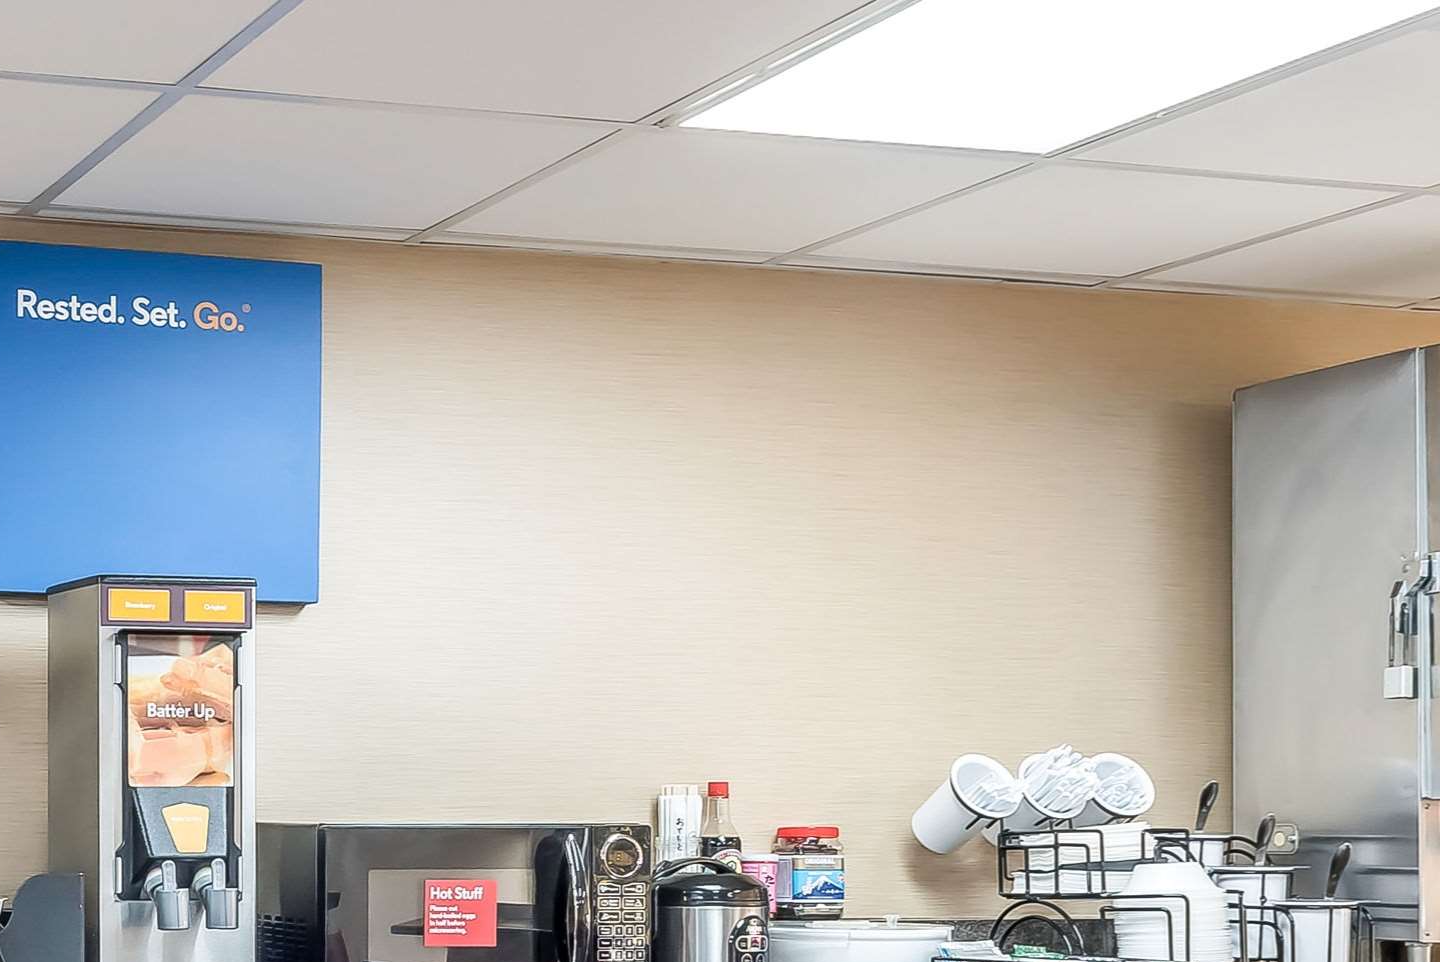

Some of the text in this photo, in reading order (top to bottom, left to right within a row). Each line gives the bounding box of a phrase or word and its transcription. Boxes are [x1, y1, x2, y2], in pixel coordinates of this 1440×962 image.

[16, 289, 246, 332] Rested. Set. Go.
[147, 702, 216, 721] Batter Up
[429, 886, 484, 900] Hot Stuff
